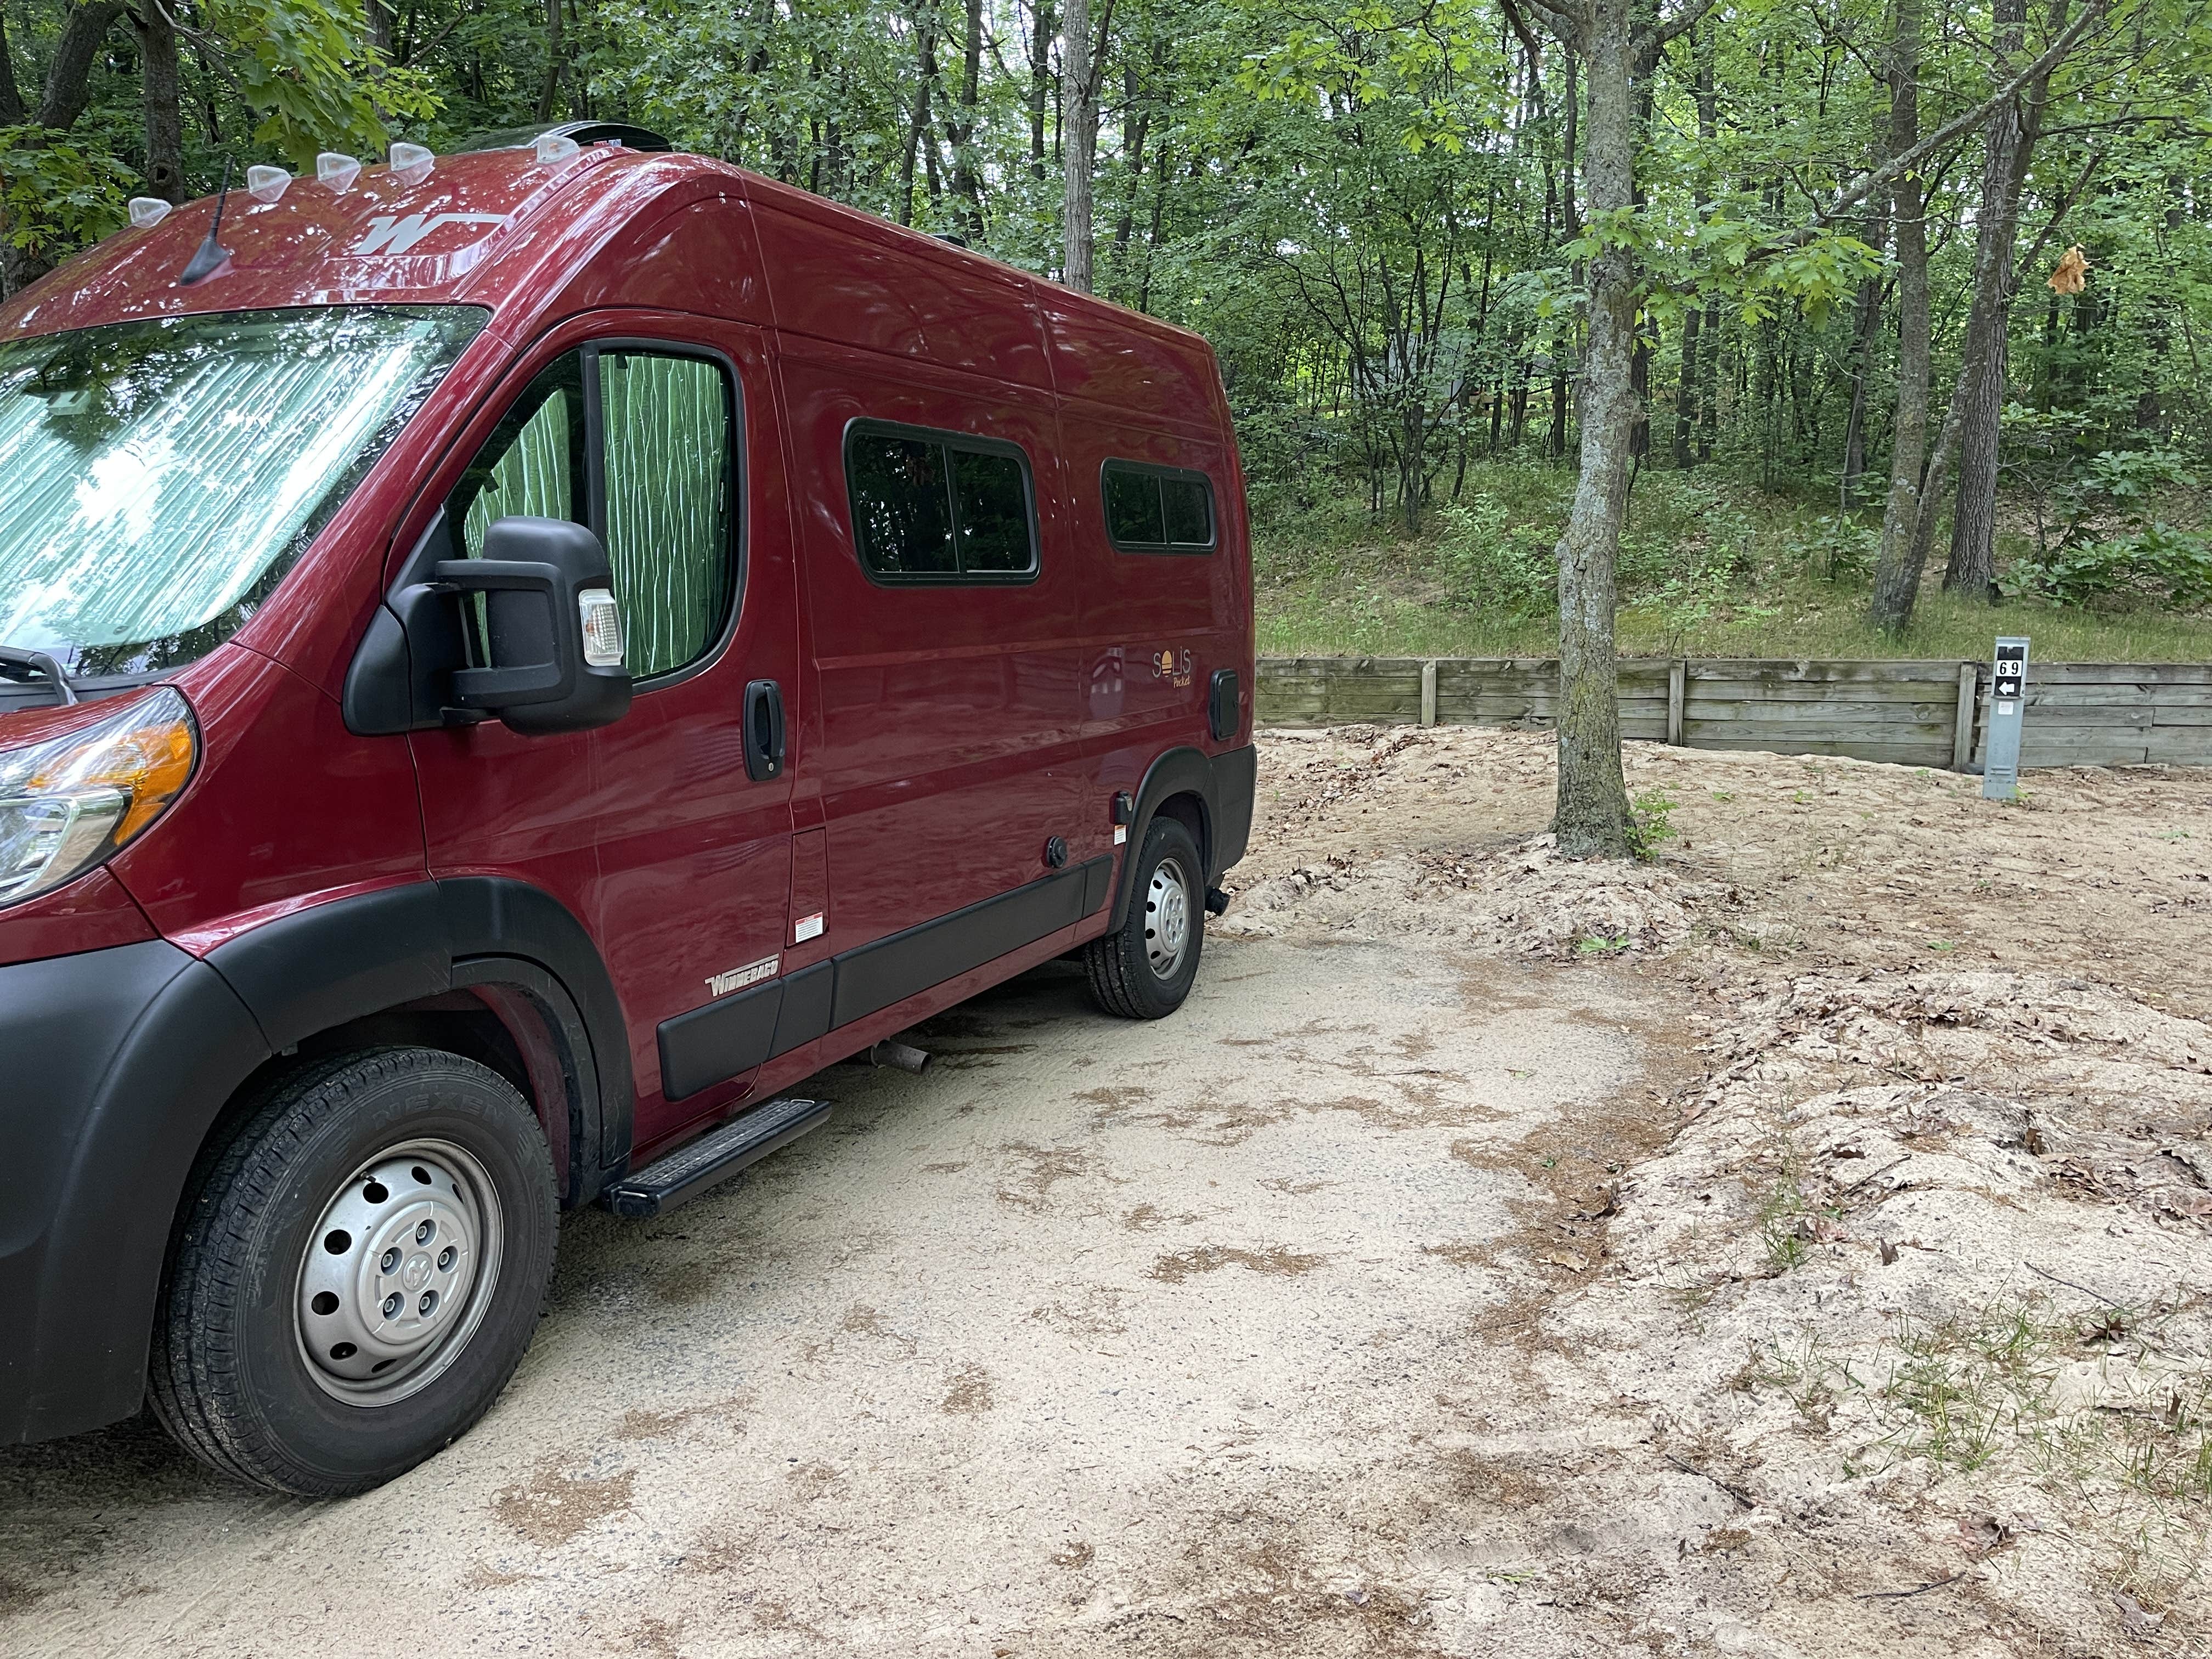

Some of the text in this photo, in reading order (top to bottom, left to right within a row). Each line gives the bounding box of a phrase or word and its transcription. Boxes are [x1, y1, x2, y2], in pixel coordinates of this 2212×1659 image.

[1999, 662, 2019, 675] 69
[1173, 675, 1191, 689] Pocket
[704, 953, 780, 997] WINNEBAGO
[371, 1092, 506, 1130] NEXEN
